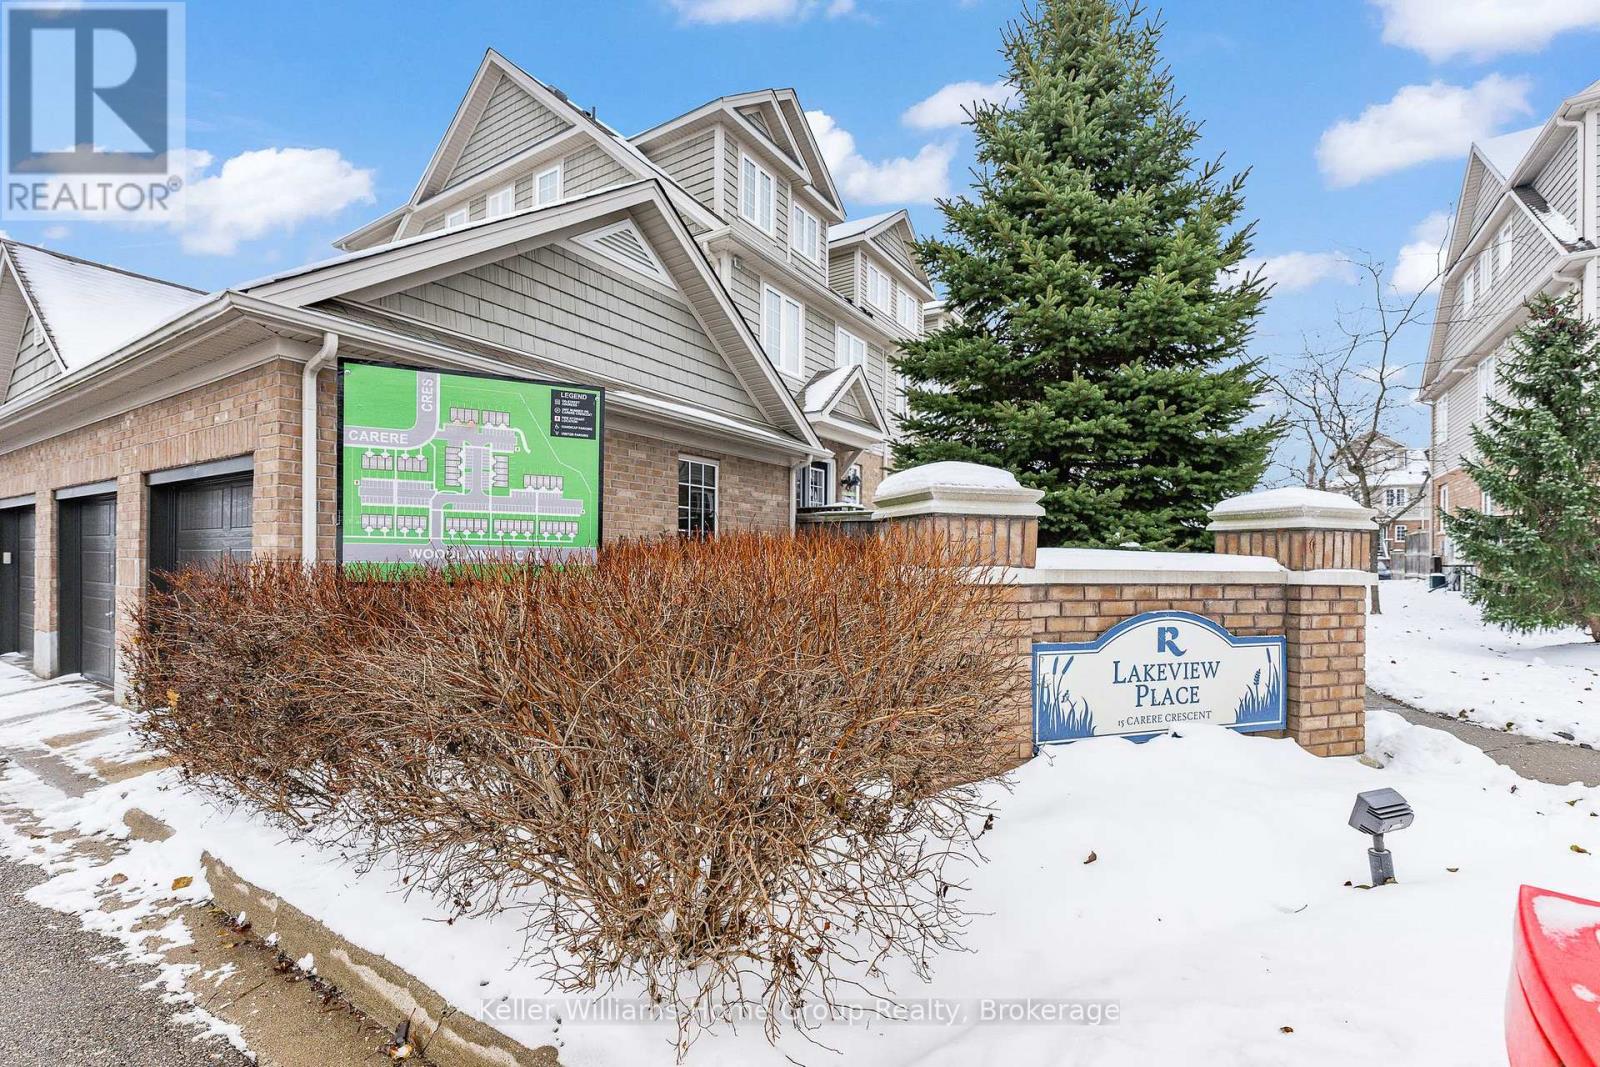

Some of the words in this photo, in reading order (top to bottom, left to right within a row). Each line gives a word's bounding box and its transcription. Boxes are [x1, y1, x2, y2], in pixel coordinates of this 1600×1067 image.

[421, 378, 433, 412] CRES
[348, 430, 409, 444] CARERE
[1157, 626, 1187, 657] R
[1112, 660, 1220, 684] LAKEVIEW
[1135, 684, 1200, 707] PLACE
[1118, 719, 1125, 728] 15
[1126, 714, 1163, 726] CARERE
[1164, 710, 1213, 723] CRESCENT
